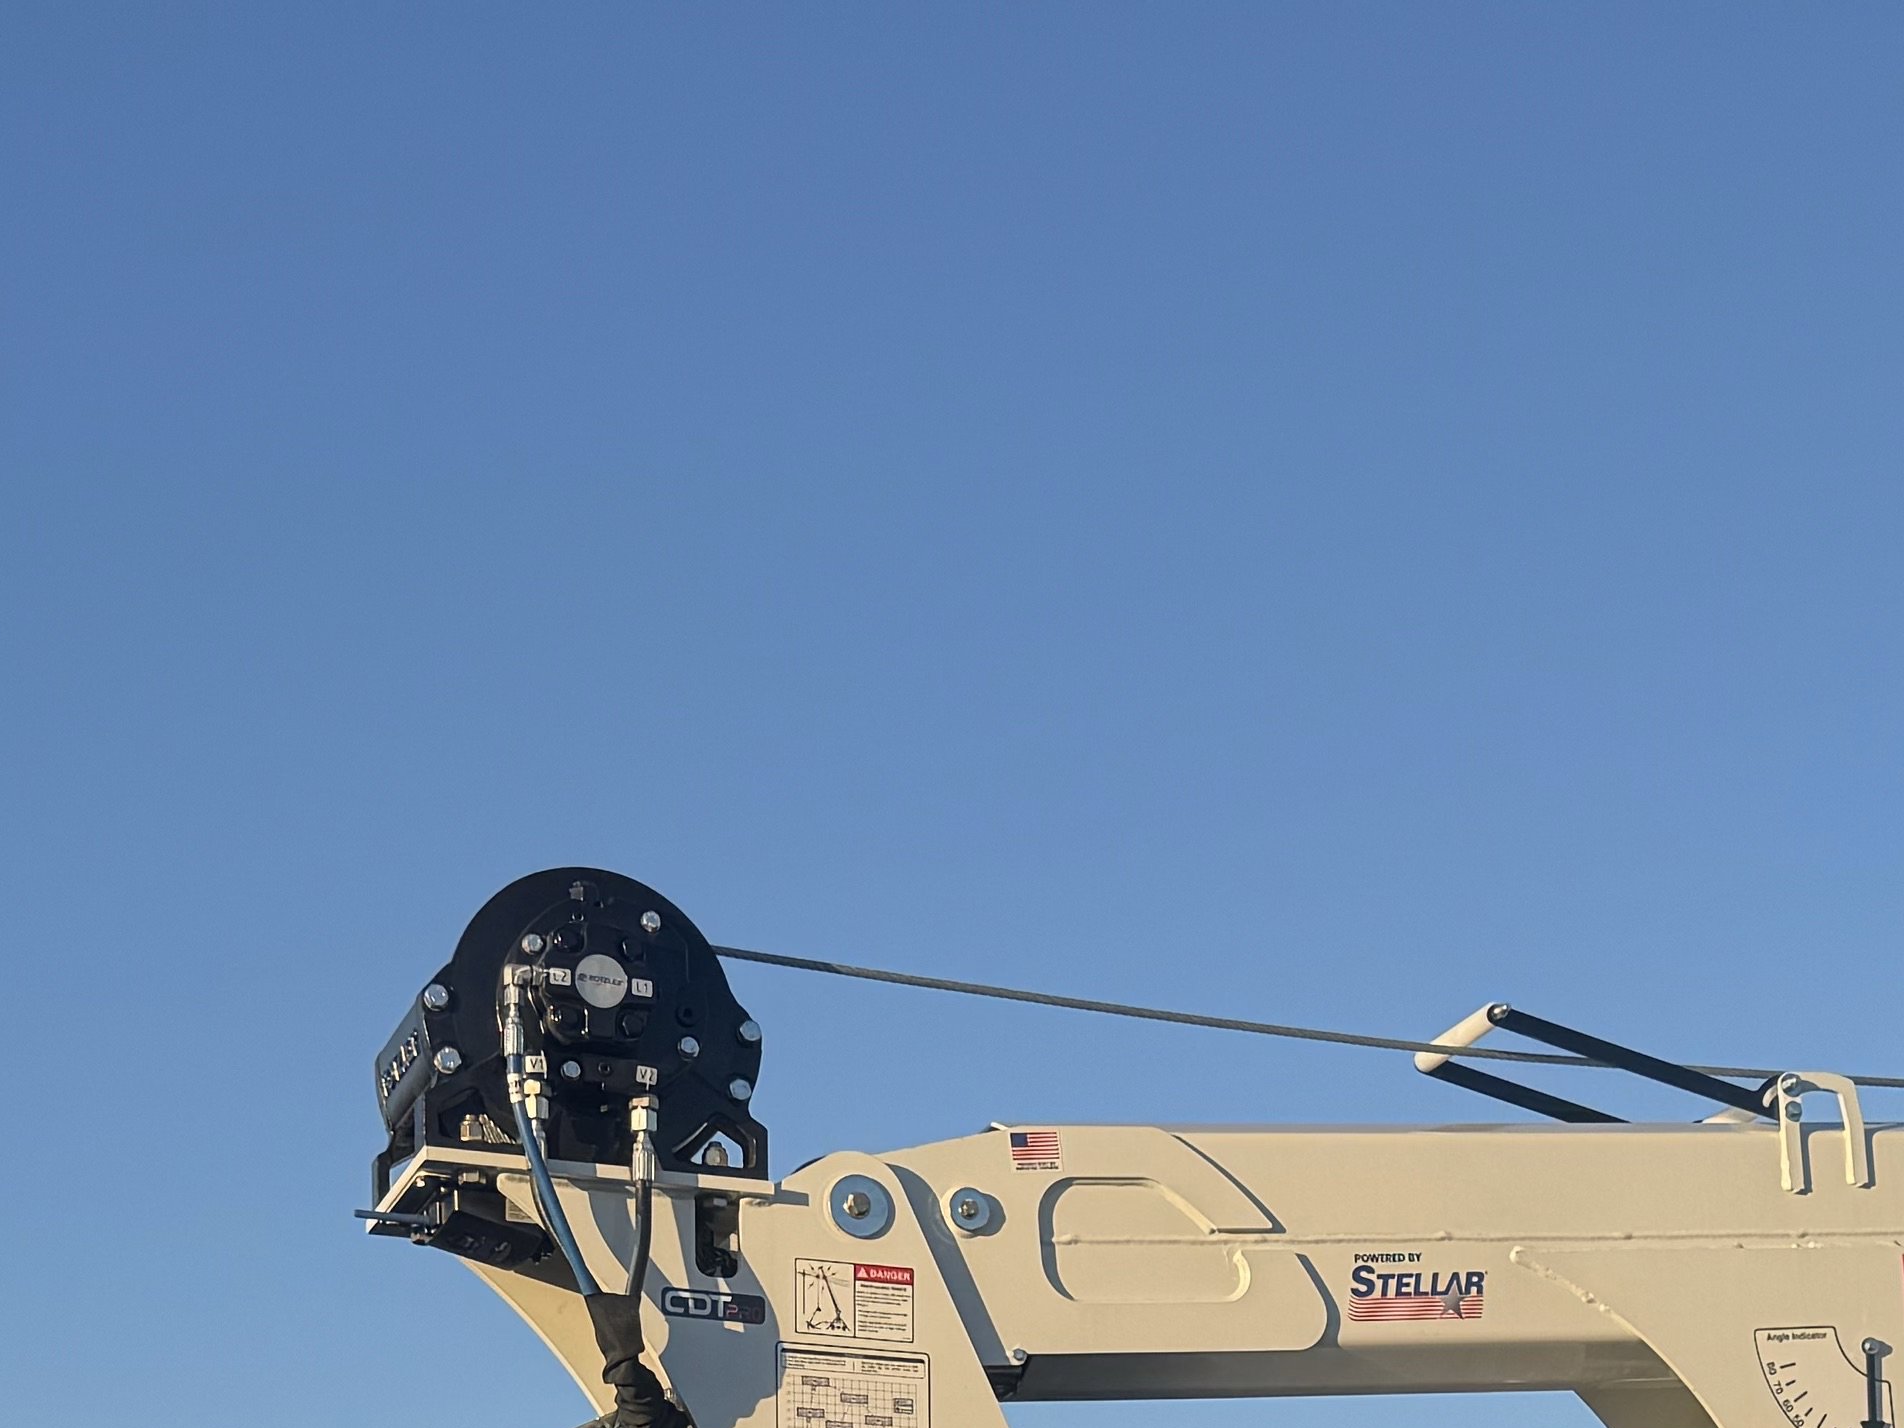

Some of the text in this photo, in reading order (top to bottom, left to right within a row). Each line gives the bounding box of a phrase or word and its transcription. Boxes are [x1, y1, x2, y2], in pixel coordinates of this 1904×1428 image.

[636, 981, 649, 993] L1
[530, 1058, 544, 1070] V1
[1354, 1252, 1422, 1263] POWERED BY
[869, 1268, 911, 1281] DANGER
[1350, 1264, 1485, 1298] STELLAR
[1766, 1331, 1827, 1343] Angle Indicator
[1773, 1381, 1784, 1395] 70
[1782, 1399, 1794, 1413] 60
